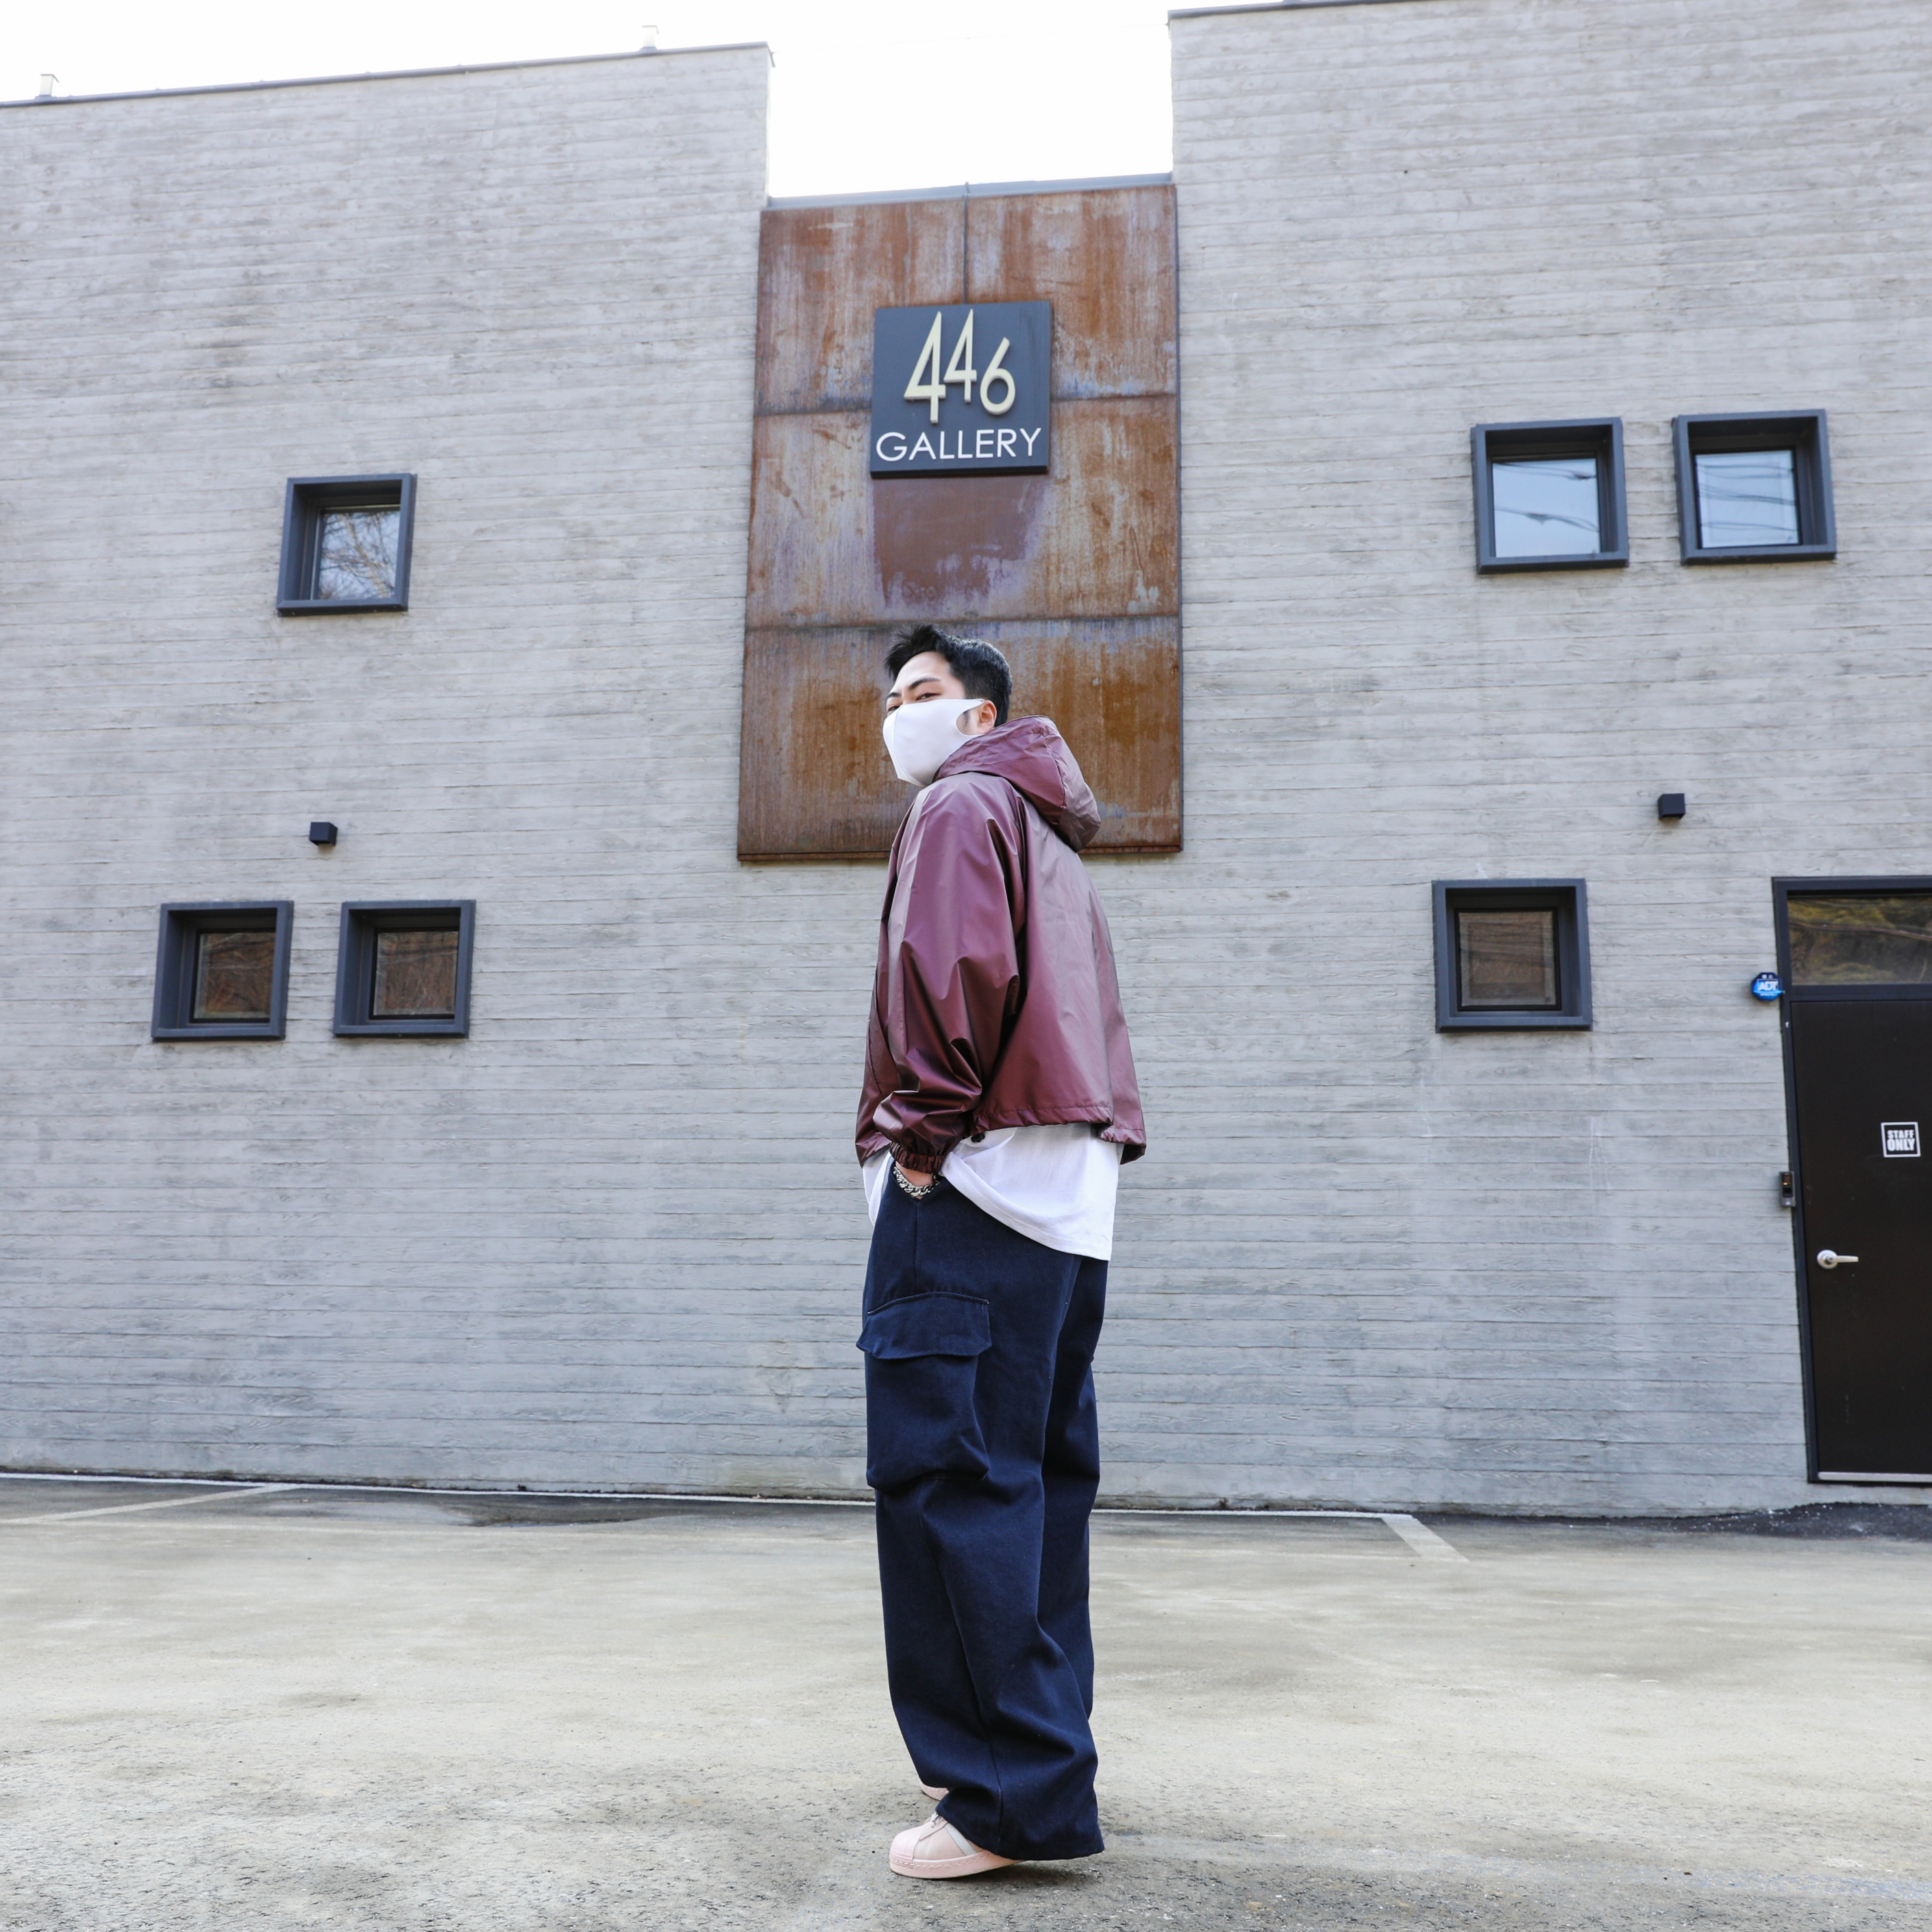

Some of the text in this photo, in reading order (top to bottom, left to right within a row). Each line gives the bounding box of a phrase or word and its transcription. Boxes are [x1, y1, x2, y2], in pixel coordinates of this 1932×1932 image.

[904, 309, 1015, 423] 446
[876, 428, 1041, 461] GALLERY
[1757, 980, 1779, 991] ADT
[1887, 1130, 1914, 1139] STAFF
[1887, 1138, 1915, 1151] ONLY
